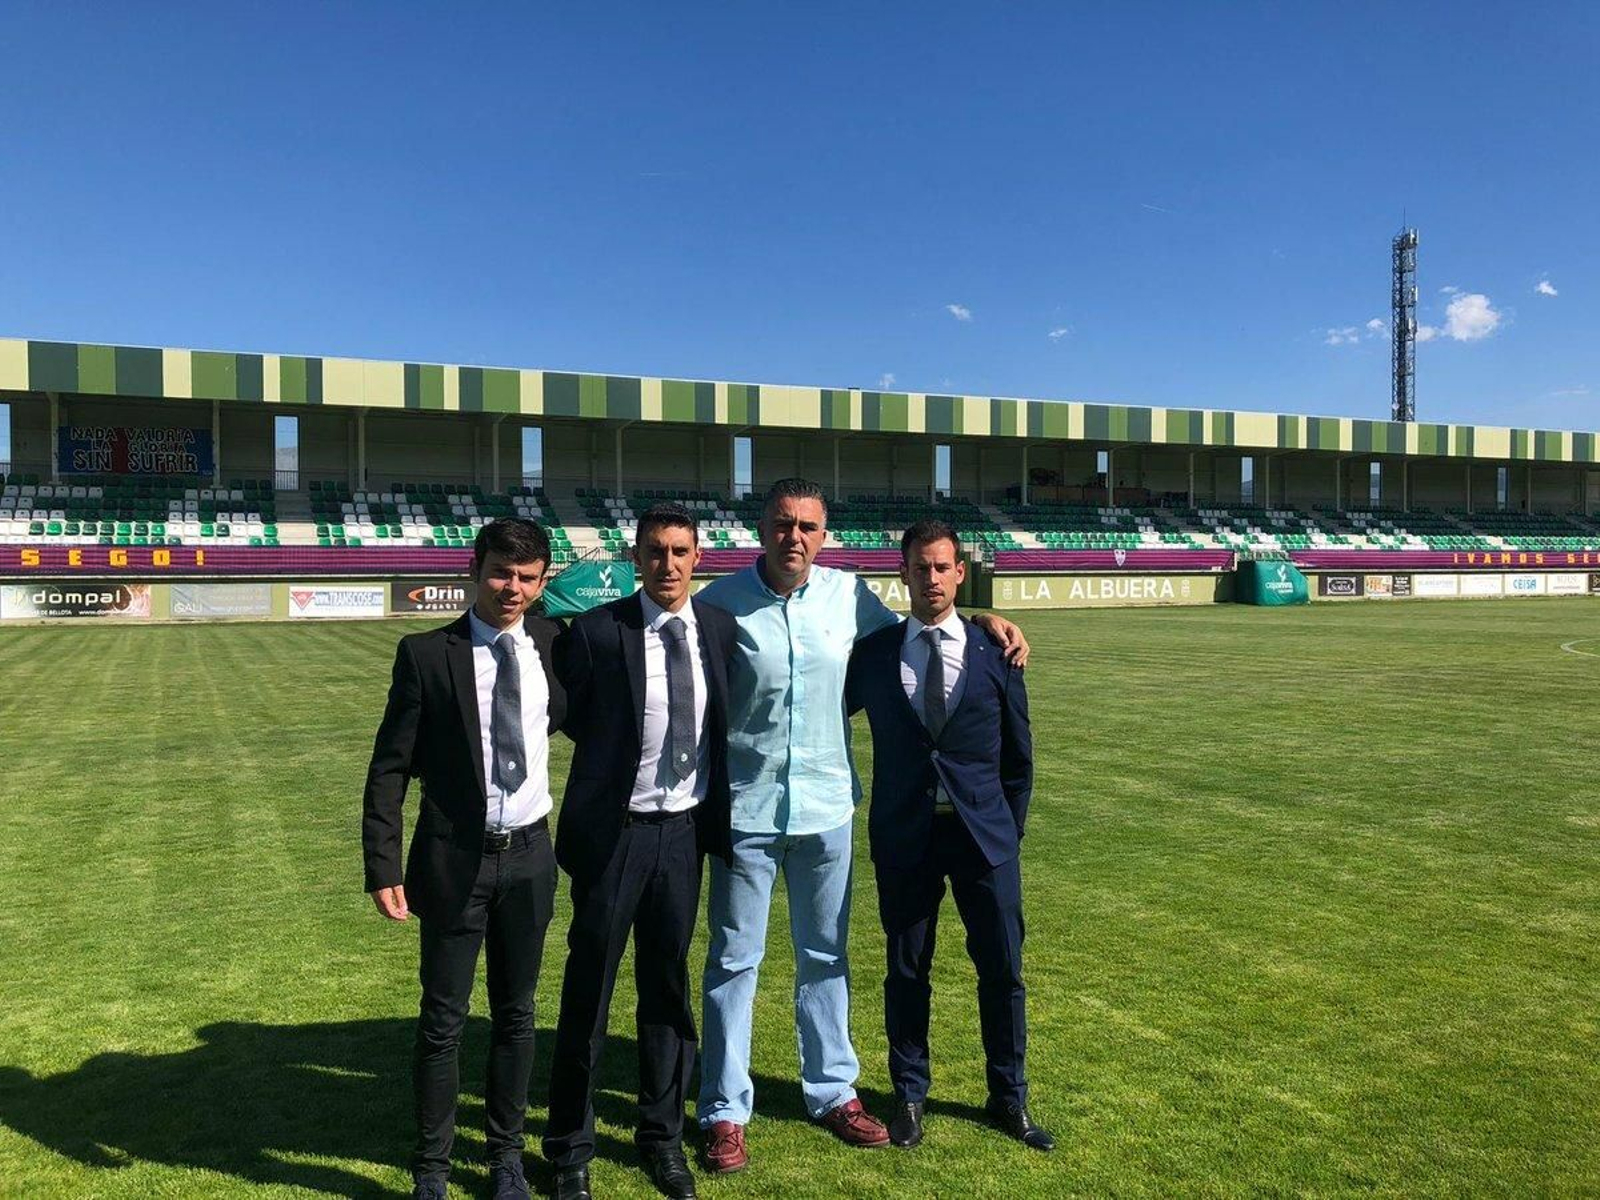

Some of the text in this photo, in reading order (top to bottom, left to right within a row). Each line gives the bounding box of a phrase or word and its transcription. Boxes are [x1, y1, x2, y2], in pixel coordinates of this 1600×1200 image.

[70, 427, 118, 441] NADA
[91, 440, 186, 453] LA GLORIA
[73, 449, 198, 473] SIN SUFRIR
[424, 585, 465, 601] Drin
[576, 584, 622, 597] cajaviva
[1021, 579, 1175, 600] LA ALBUERA
[32, 590, 121, 606] dompal
